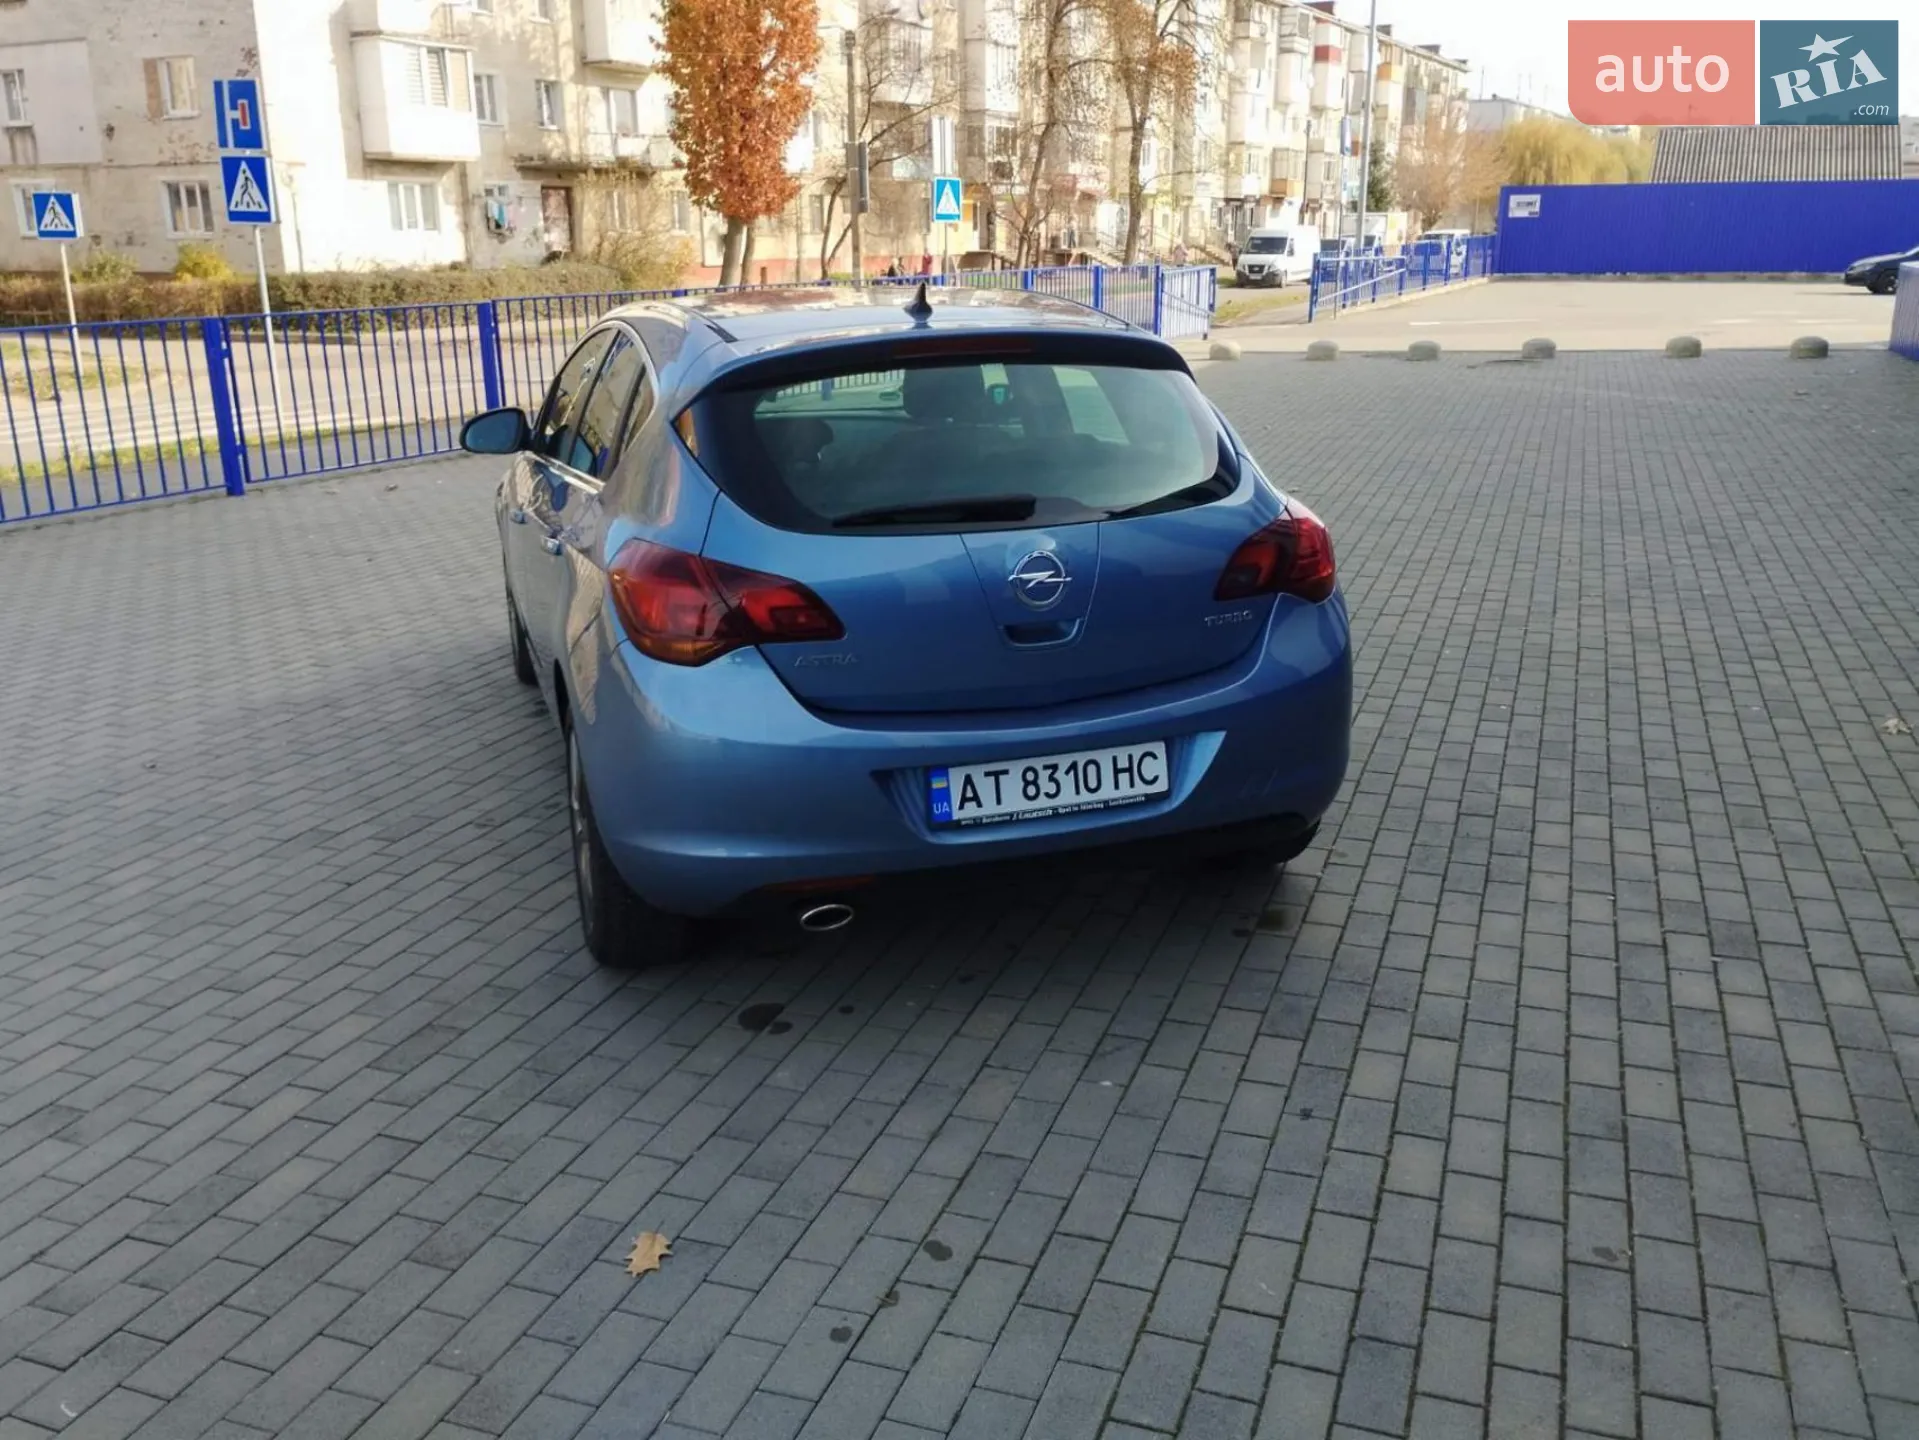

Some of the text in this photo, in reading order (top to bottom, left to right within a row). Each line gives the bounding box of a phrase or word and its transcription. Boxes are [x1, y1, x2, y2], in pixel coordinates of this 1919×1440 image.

[1203, 610, 1253, 628] TURBO
[794, 653, 859, 668] ASTRA
[957, 750, 1160, 812] AT 8310 HC
[933, 801, 951, 815] UA
